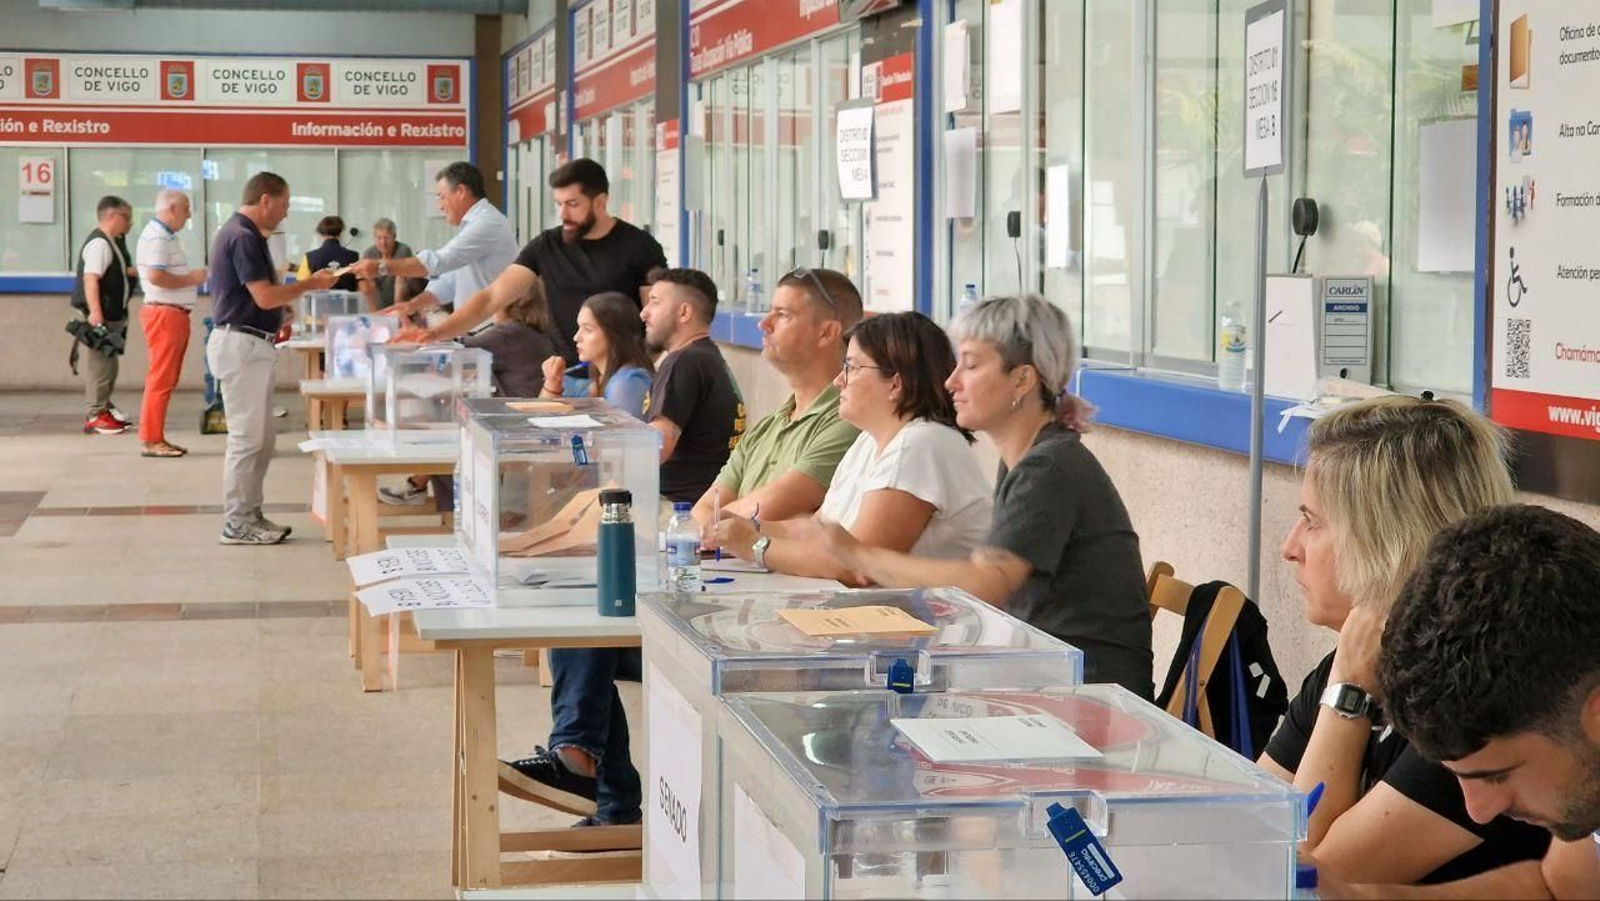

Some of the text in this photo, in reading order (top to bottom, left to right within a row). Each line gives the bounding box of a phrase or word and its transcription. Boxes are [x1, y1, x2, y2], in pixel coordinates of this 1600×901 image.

[1559, 25, 1585, 42] Oficina
[1586, 22, 1596, 37] de
[74, 66, 149, 79] CONCELLO
[212, 69, 286, 81] CONCELLO
[345, 71, 417, 83] CONCELLO
[84, 80, 141, 93] DE VIGO
[221, 82, 278, 95] DE VIGO
[353, 84, 409, 97] DE VIGO
[28, 122, 38, 133] e
[43, 119, 111, 134] Rexistro
[291, 121, 465, 138] Información e Rexistro
[1256, 117, 1271, 140] MESA
[1559, 123, 1575, 138] Alta
[22, 162, 51, 184] 16
[1556, 191, 1594, 208] Formación
[1556, 264, 1588, 280] Atención
[659, 775, 687, 844] SENADO
